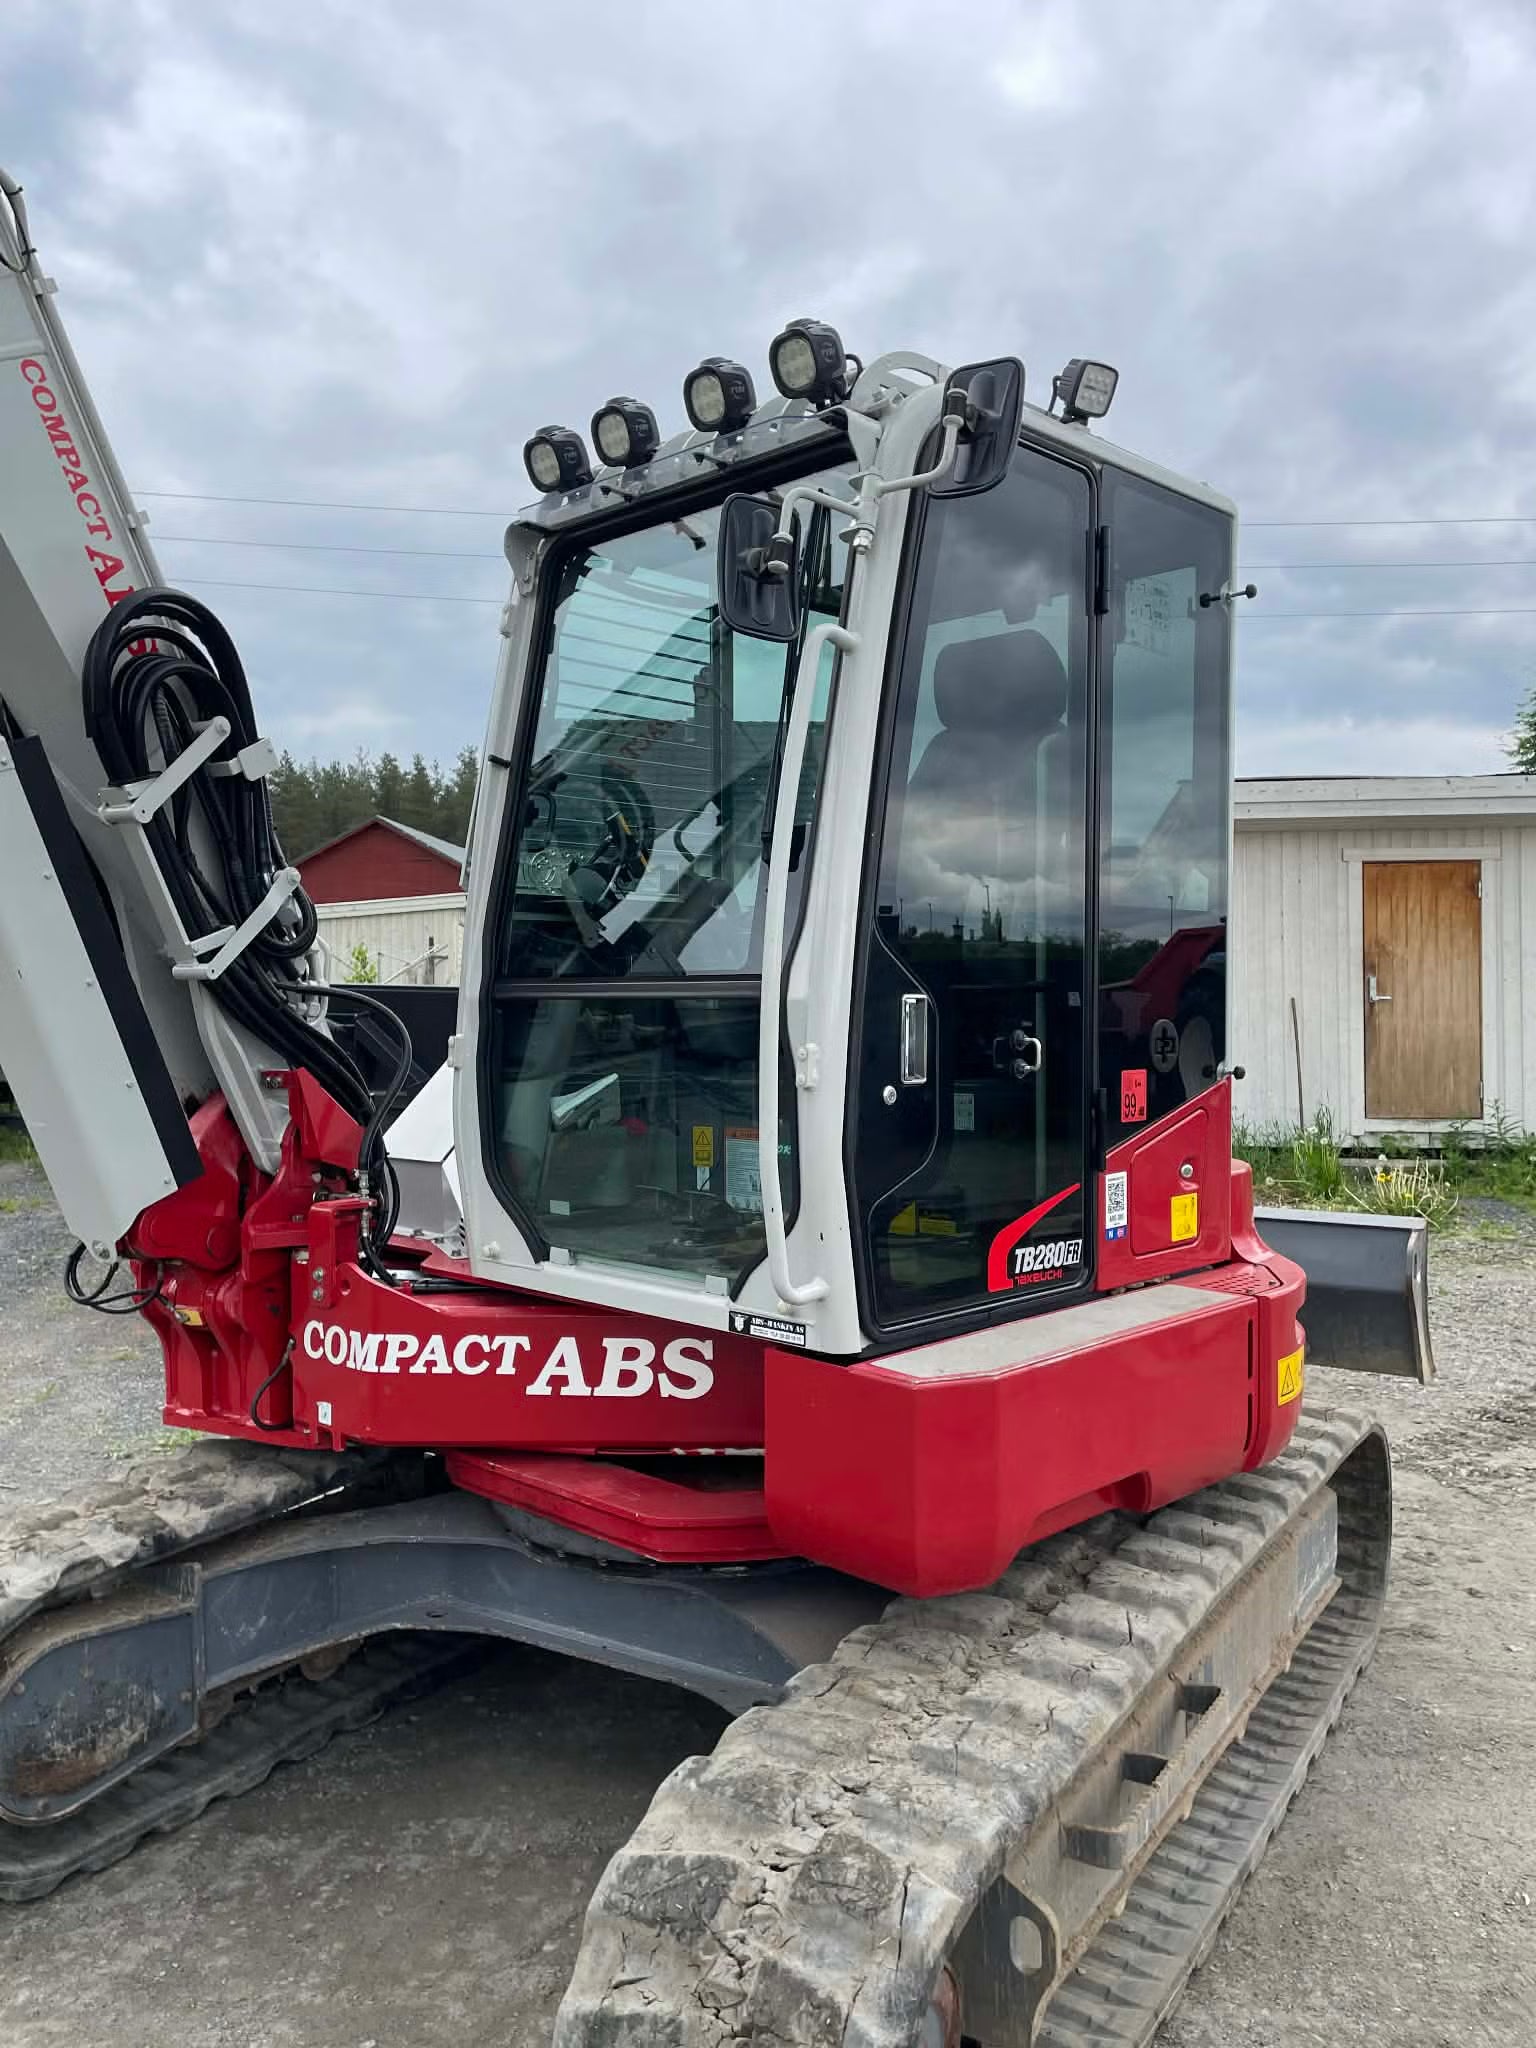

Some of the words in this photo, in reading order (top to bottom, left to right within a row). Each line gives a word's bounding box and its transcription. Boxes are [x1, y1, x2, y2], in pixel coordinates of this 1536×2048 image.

[20, 358, 113, 542] COMPACT
[1124, 1093, 1137, 1118] 99
[303, 1319, 531, 1376] COMPACT
[525, 1336, 715, 1400] ABS
